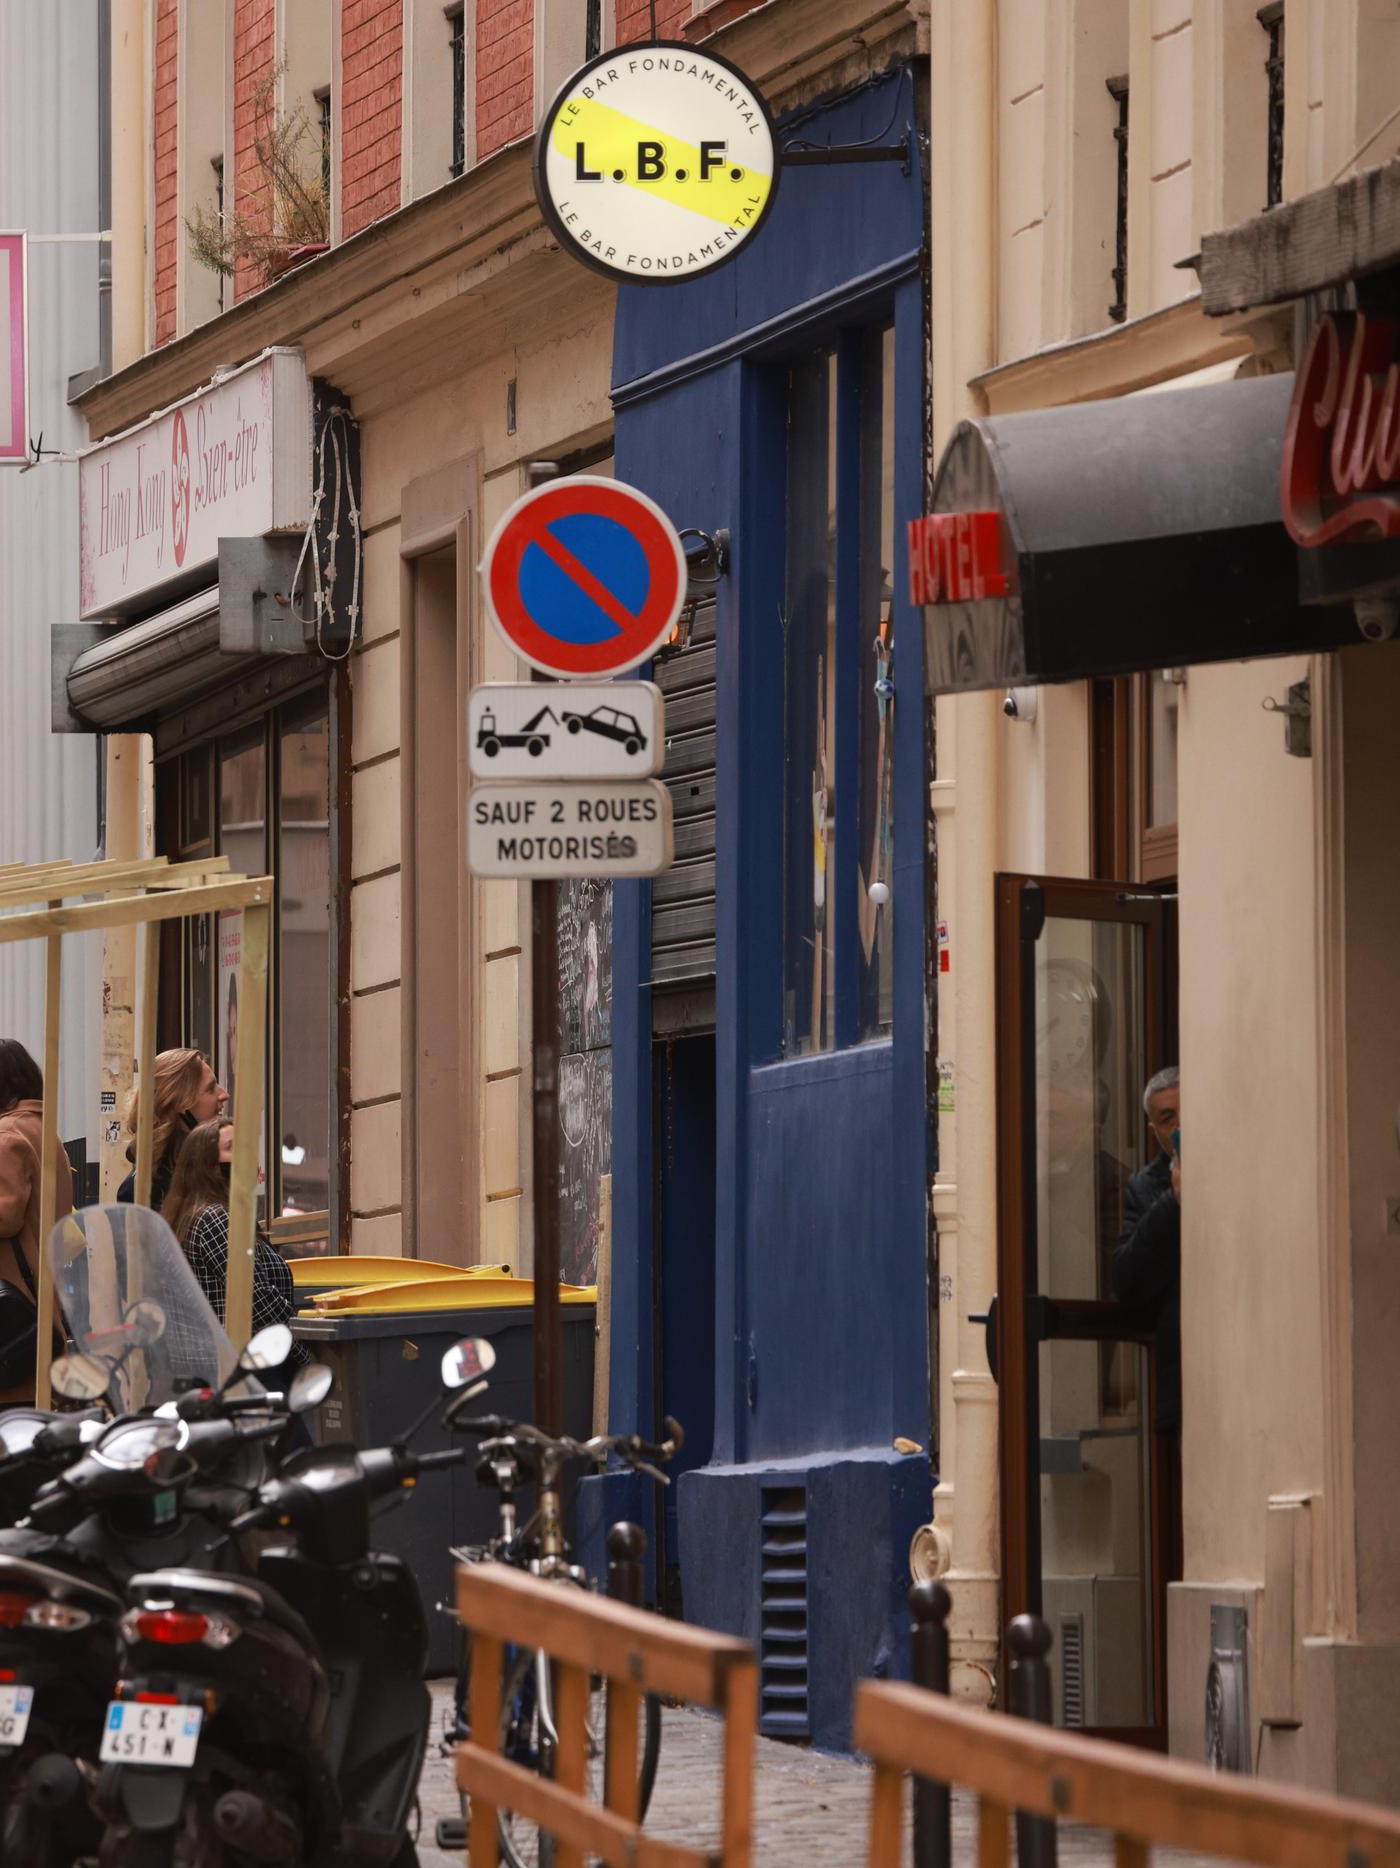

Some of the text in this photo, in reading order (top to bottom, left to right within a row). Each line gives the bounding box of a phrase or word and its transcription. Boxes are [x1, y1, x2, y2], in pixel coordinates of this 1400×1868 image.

[560, 58, 761, 135] LE BAR FONDAMENTAL
[576, 140, 746, 182] L.B.F.
[559, 194, 761, 269] LE BAR FONDAMENTAL
[99, 460, 131, 585] Hong
[136, 443, 166, 569] Kong
[908, 513, 985, 606] HOTEL
[475, 798, 658, 824] SAUF 2 ROUES
[497, 831, 638, 860] MOTORISÉS
